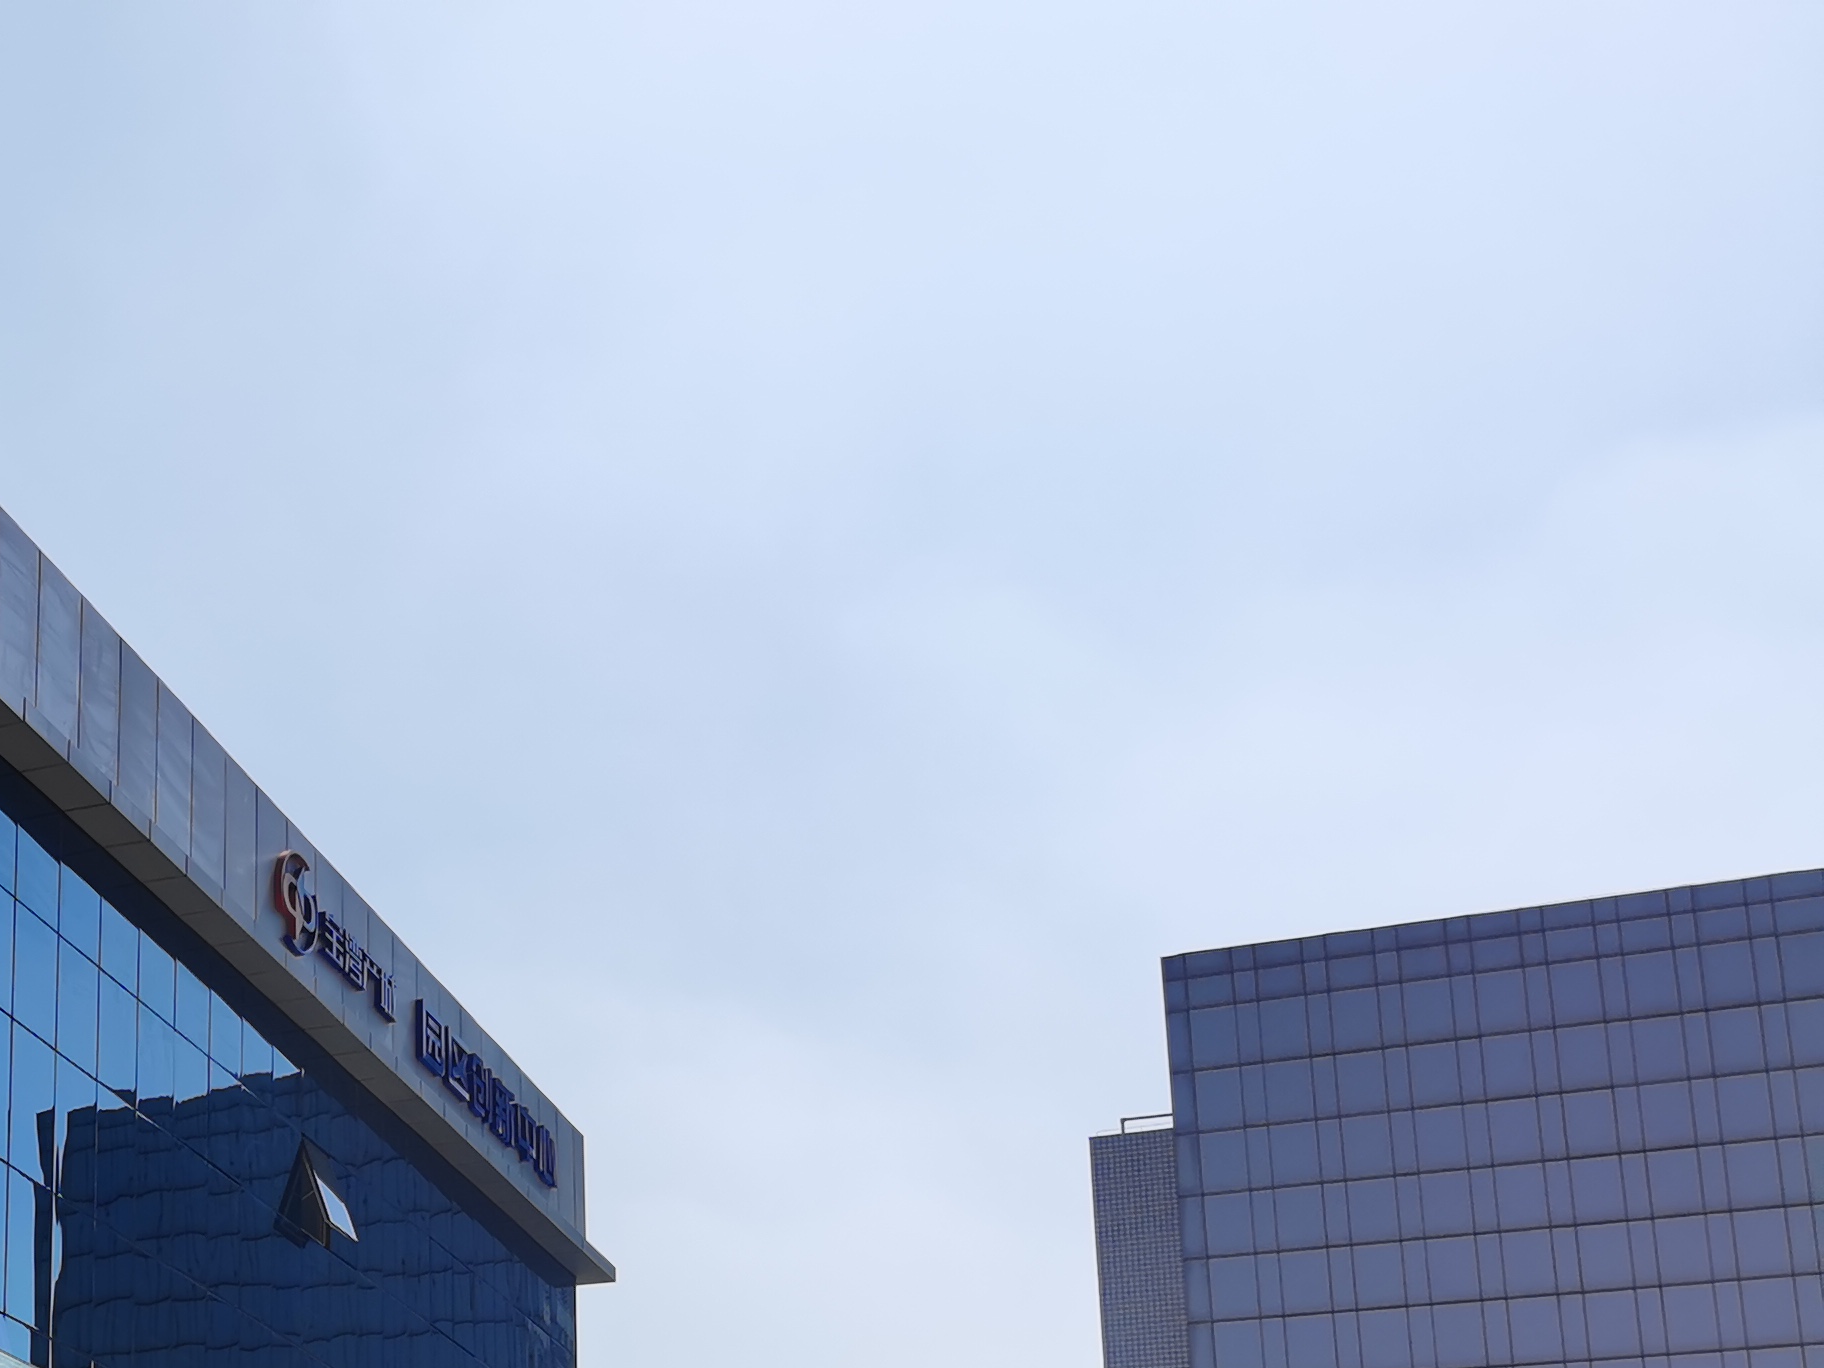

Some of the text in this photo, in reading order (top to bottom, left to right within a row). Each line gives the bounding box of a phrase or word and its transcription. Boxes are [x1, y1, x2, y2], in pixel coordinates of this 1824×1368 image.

[416, 998, 558, 1189] 园区创新中心
